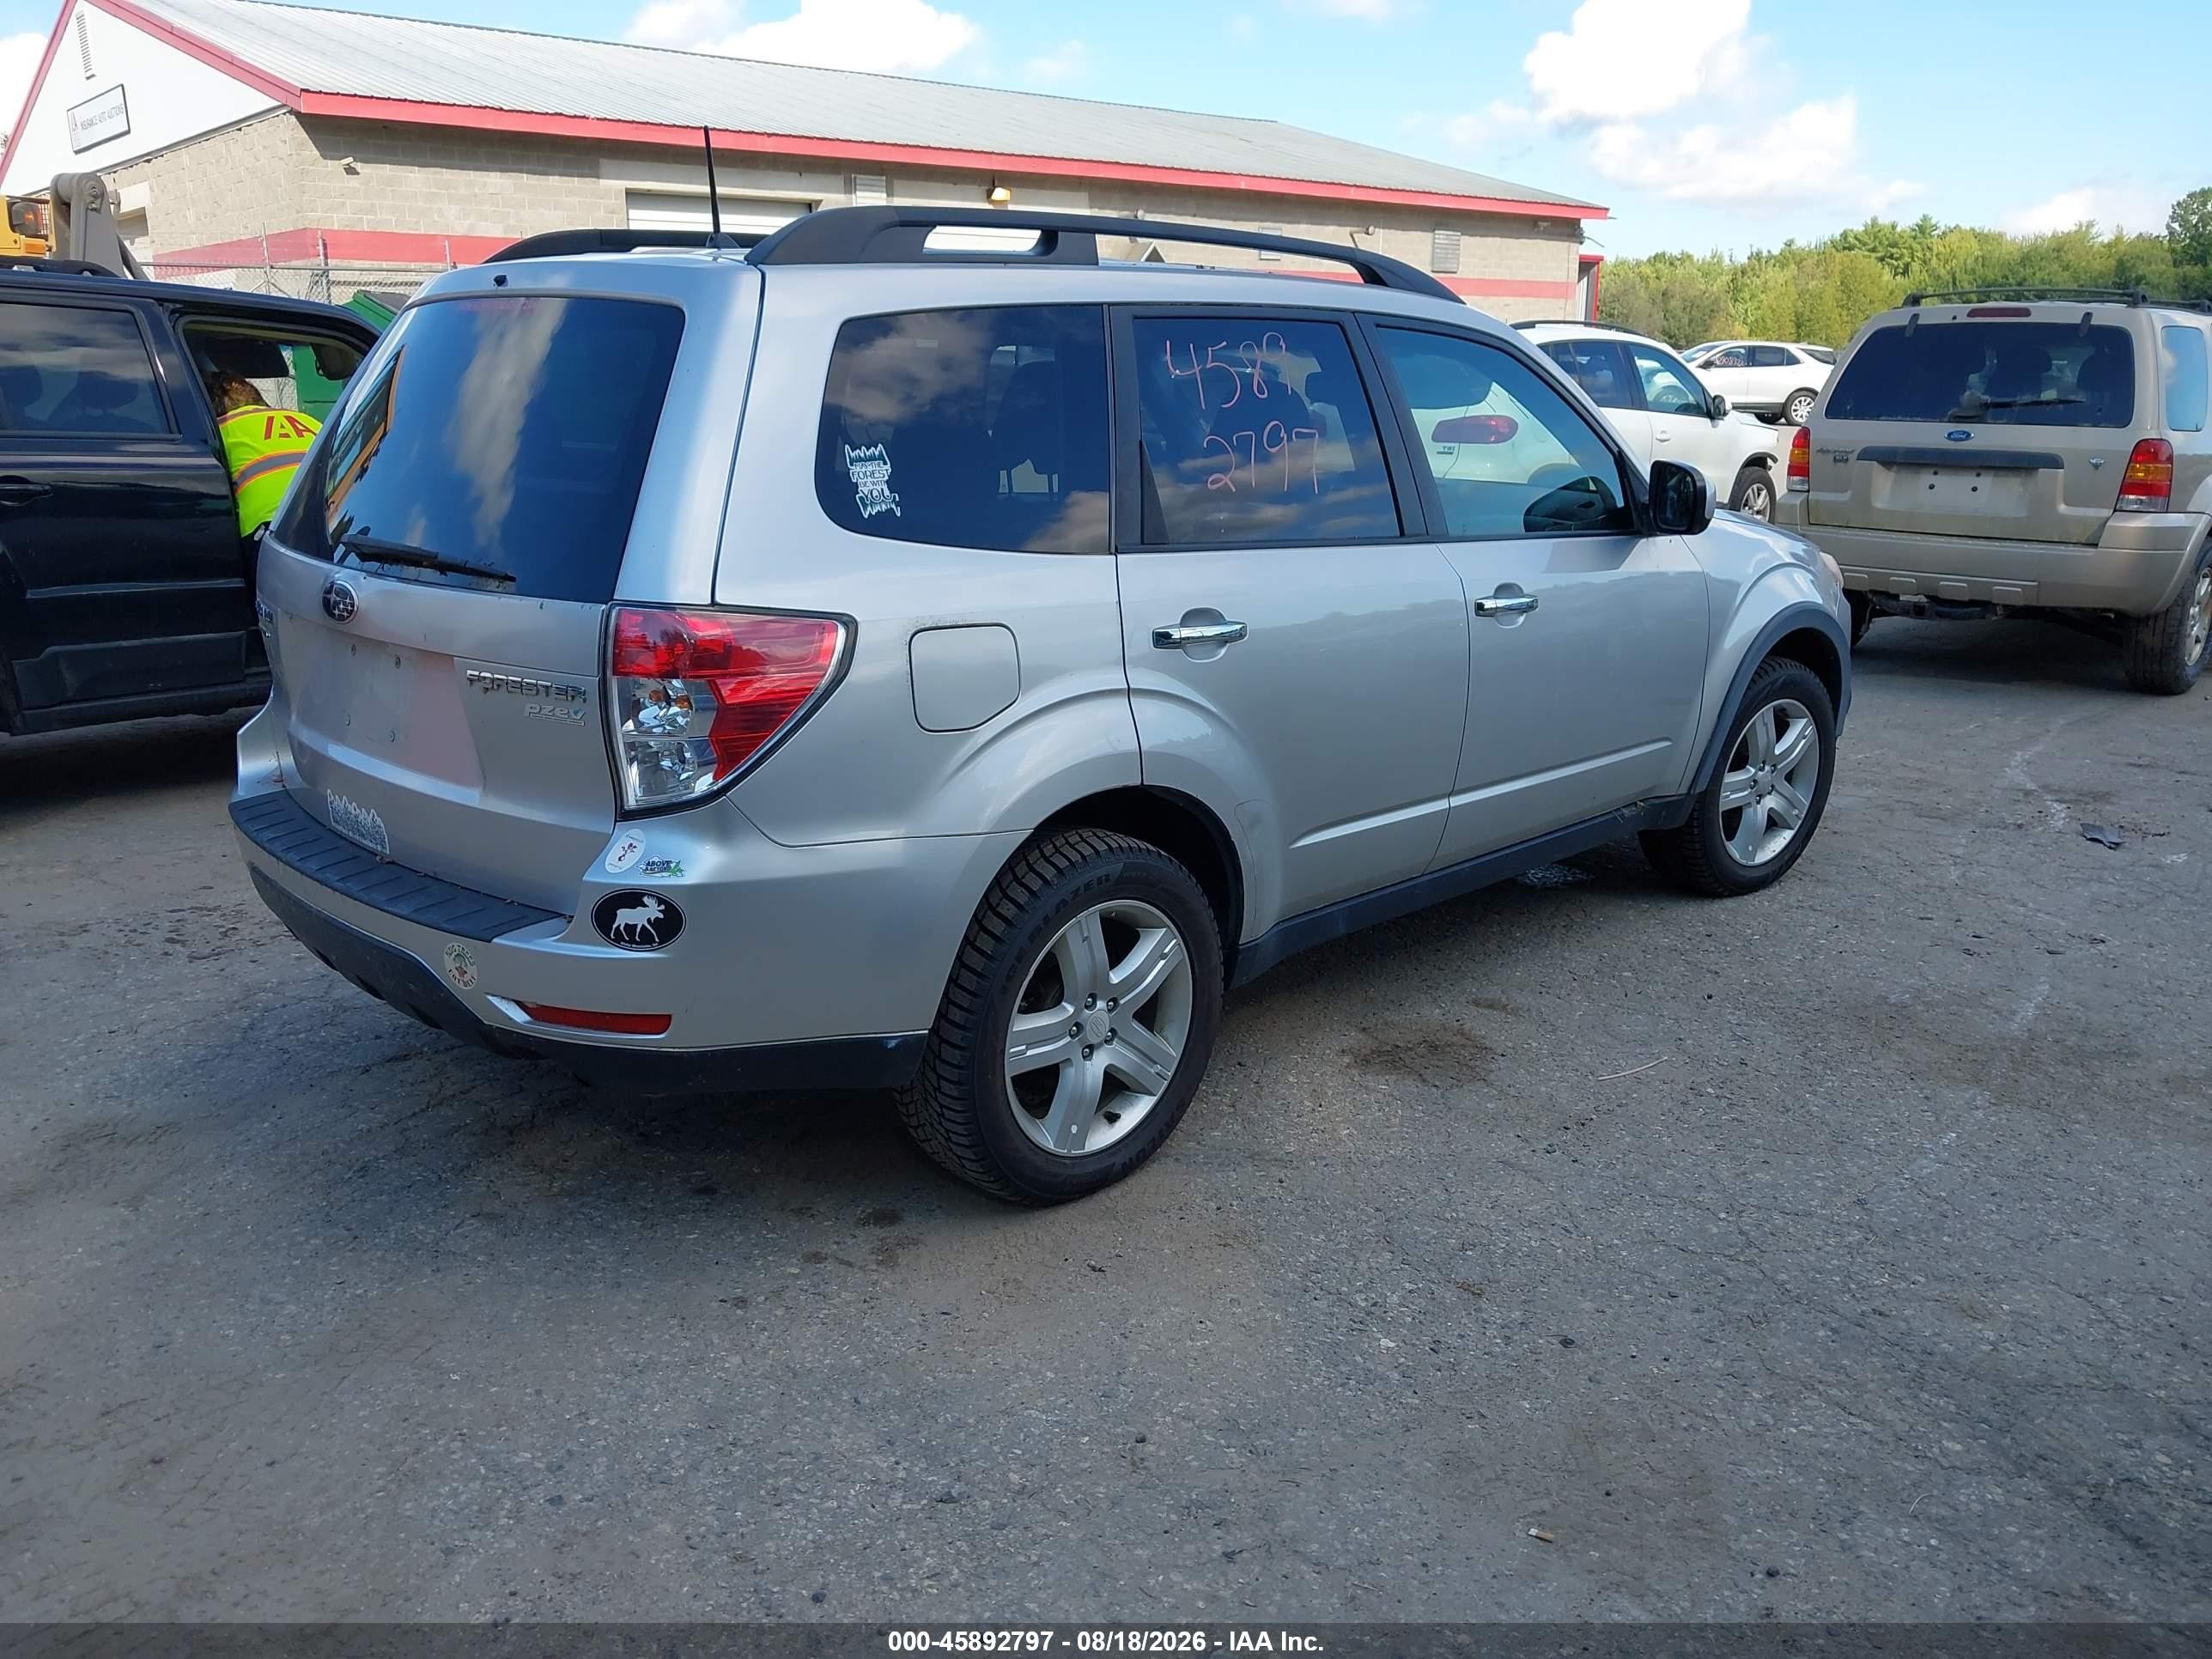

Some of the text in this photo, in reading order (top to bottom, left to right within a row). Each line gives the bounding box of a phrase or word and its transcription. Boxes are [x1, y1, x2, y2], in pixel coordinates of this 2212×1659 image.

[1165, 331, 1292, 410] 4589
[851, 468, 891, 481] FOREST
[1203, 420, 1319, 495] 2797
[860, 488, 892, 502] YOU
[466, 669, 587, 703] FORESTER
